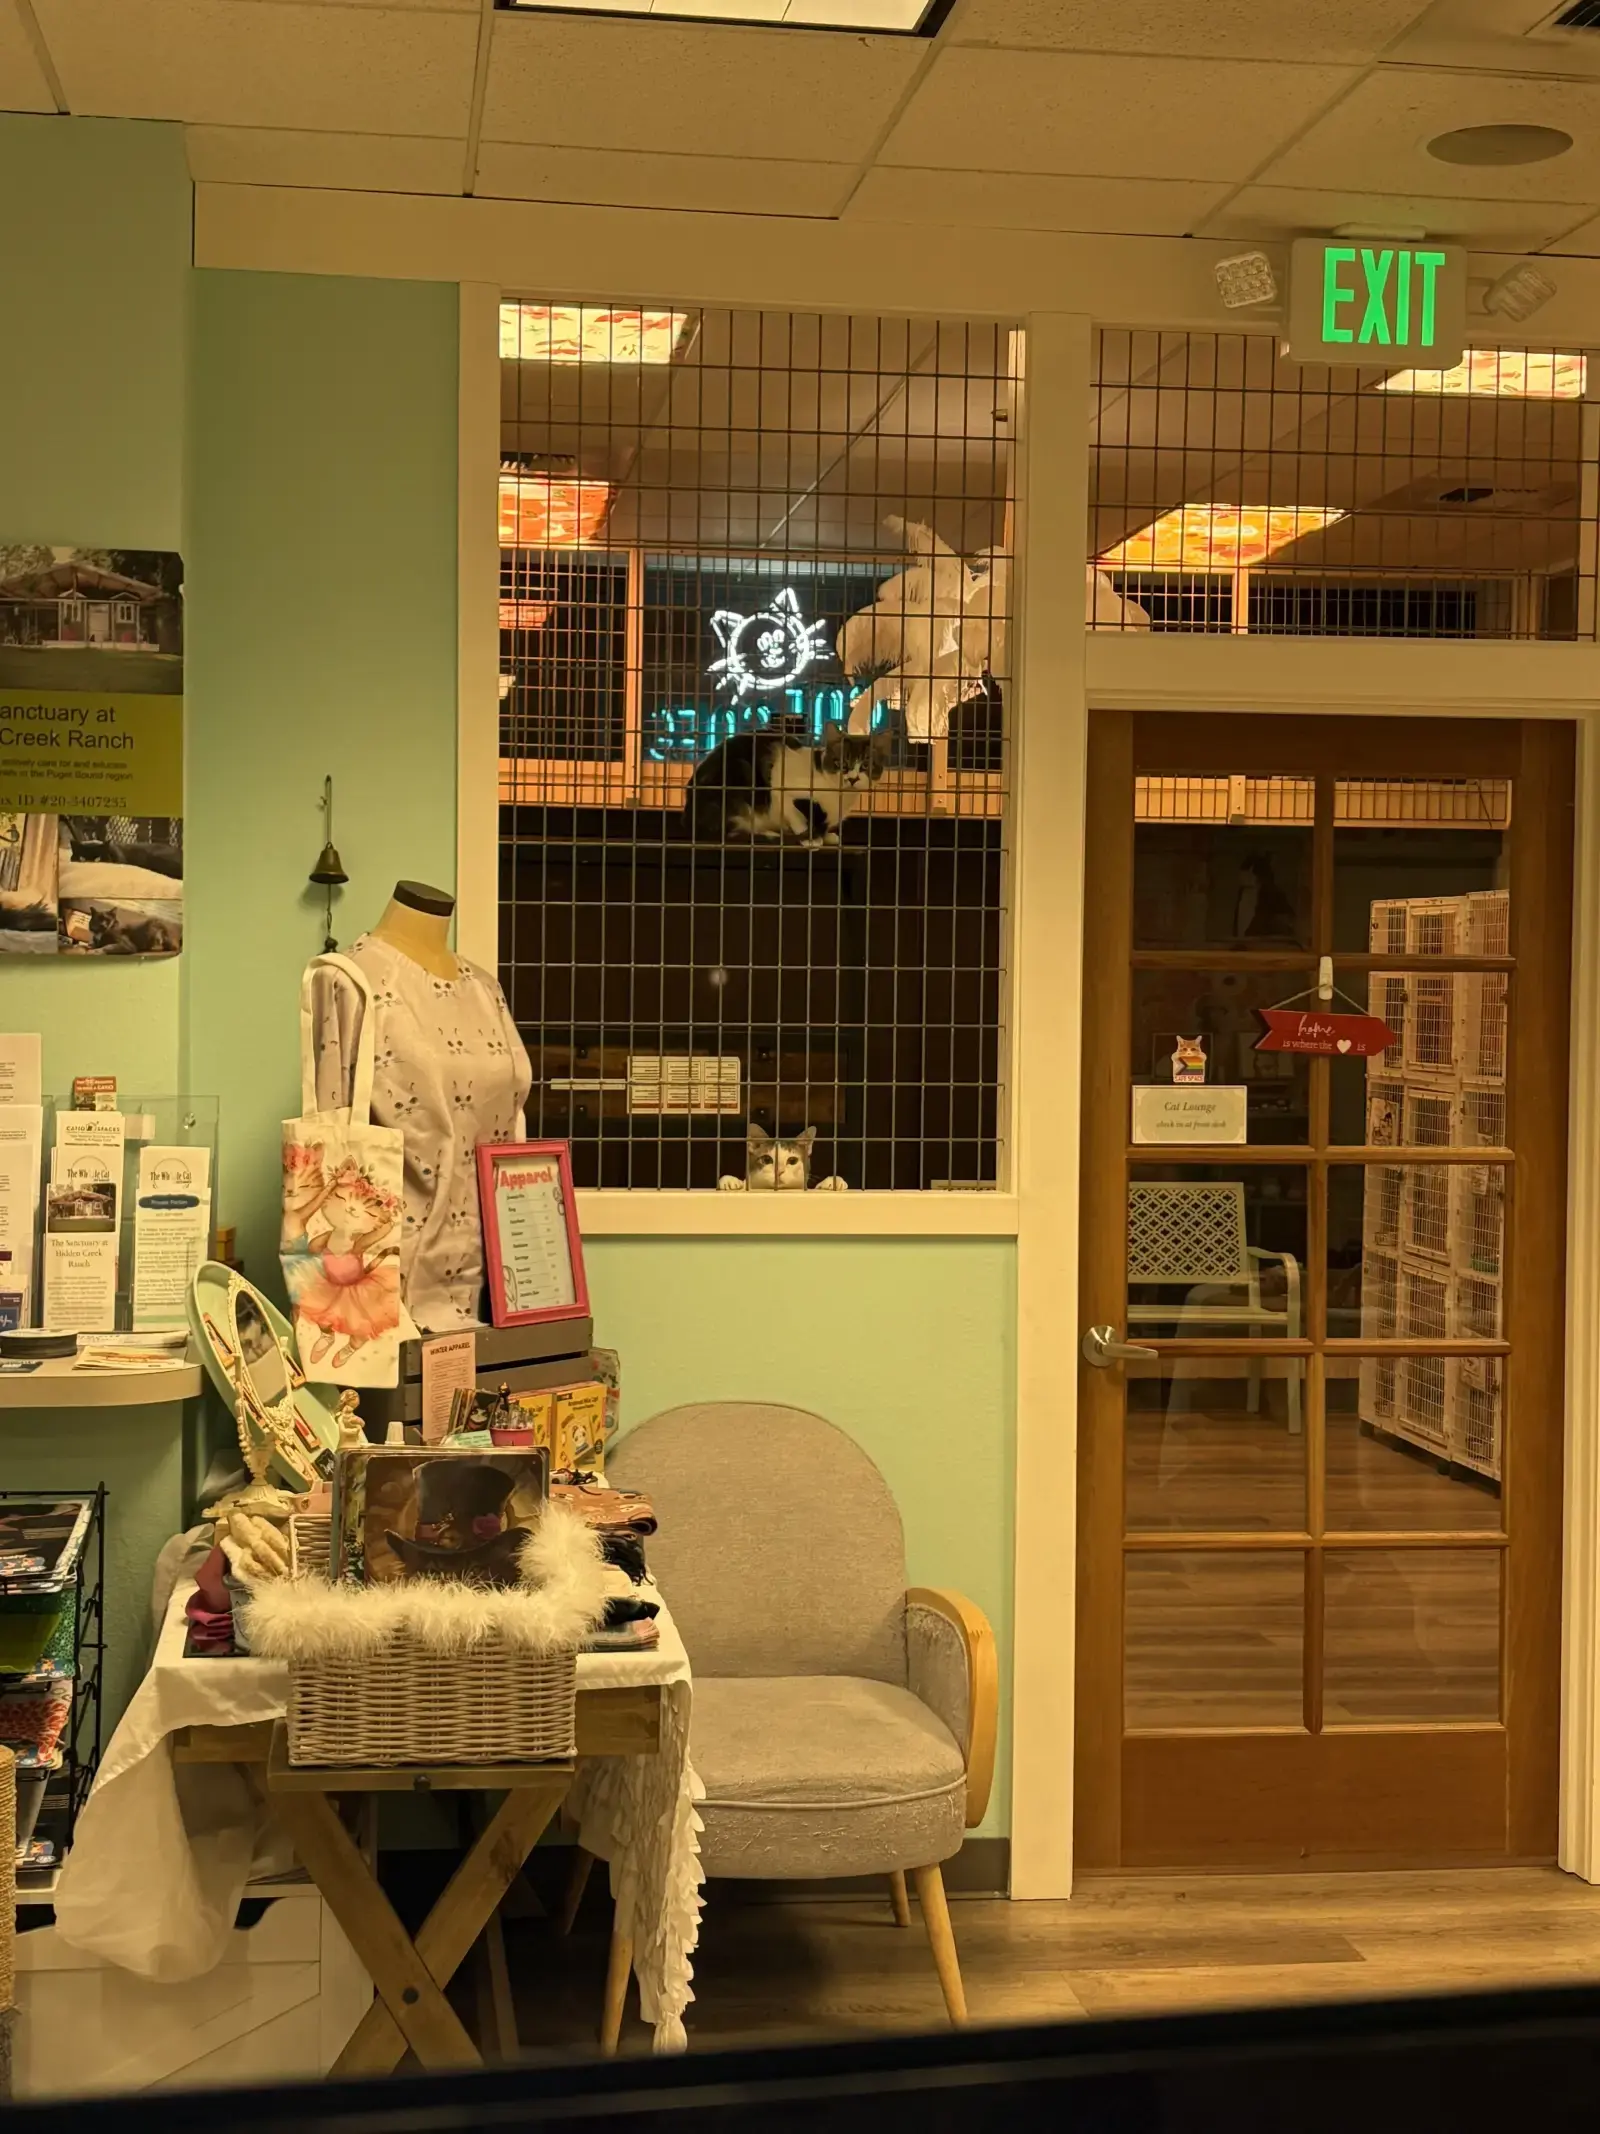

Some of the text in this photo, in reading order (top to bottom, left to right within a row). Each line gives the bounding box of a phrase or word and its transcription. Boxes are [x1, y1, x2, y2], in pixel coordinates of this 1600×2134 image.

[1321, 246, 1446, 347] EXIT
[96, 706, 116, 722] at
[0, 727, 134, 750] Creek Ranch
[73, 760, 91, 768] and
[30, 769, 44, 778] the
[46, 769, 73, 780] Puget
[75, 770, 104, 780] Sound
[105, 772, 134, 782] region
[18, 793, 34, 806] ID
[1283, 1039, 1366, 1051] is where the is
[1164, 1101, 1217, 1114] Cat Lounge
[67, 1168, 78, 1178] The
[101, 1169, 109, 1178] Cat
[150, 1171, 160, 1181] The
[182, 1171, 191, 1180] Cat
[500, 1166, 553, 1190] Apparel
[51, 1239, 64, 1248] The
[66, 1239, 100, 1248] Sanctuary
[82, 1249, 103, 1257] Creek
[68, 1259, 91, 1268] Ranch
[429, 1341, 471, 1356] WINTER APPAREL
